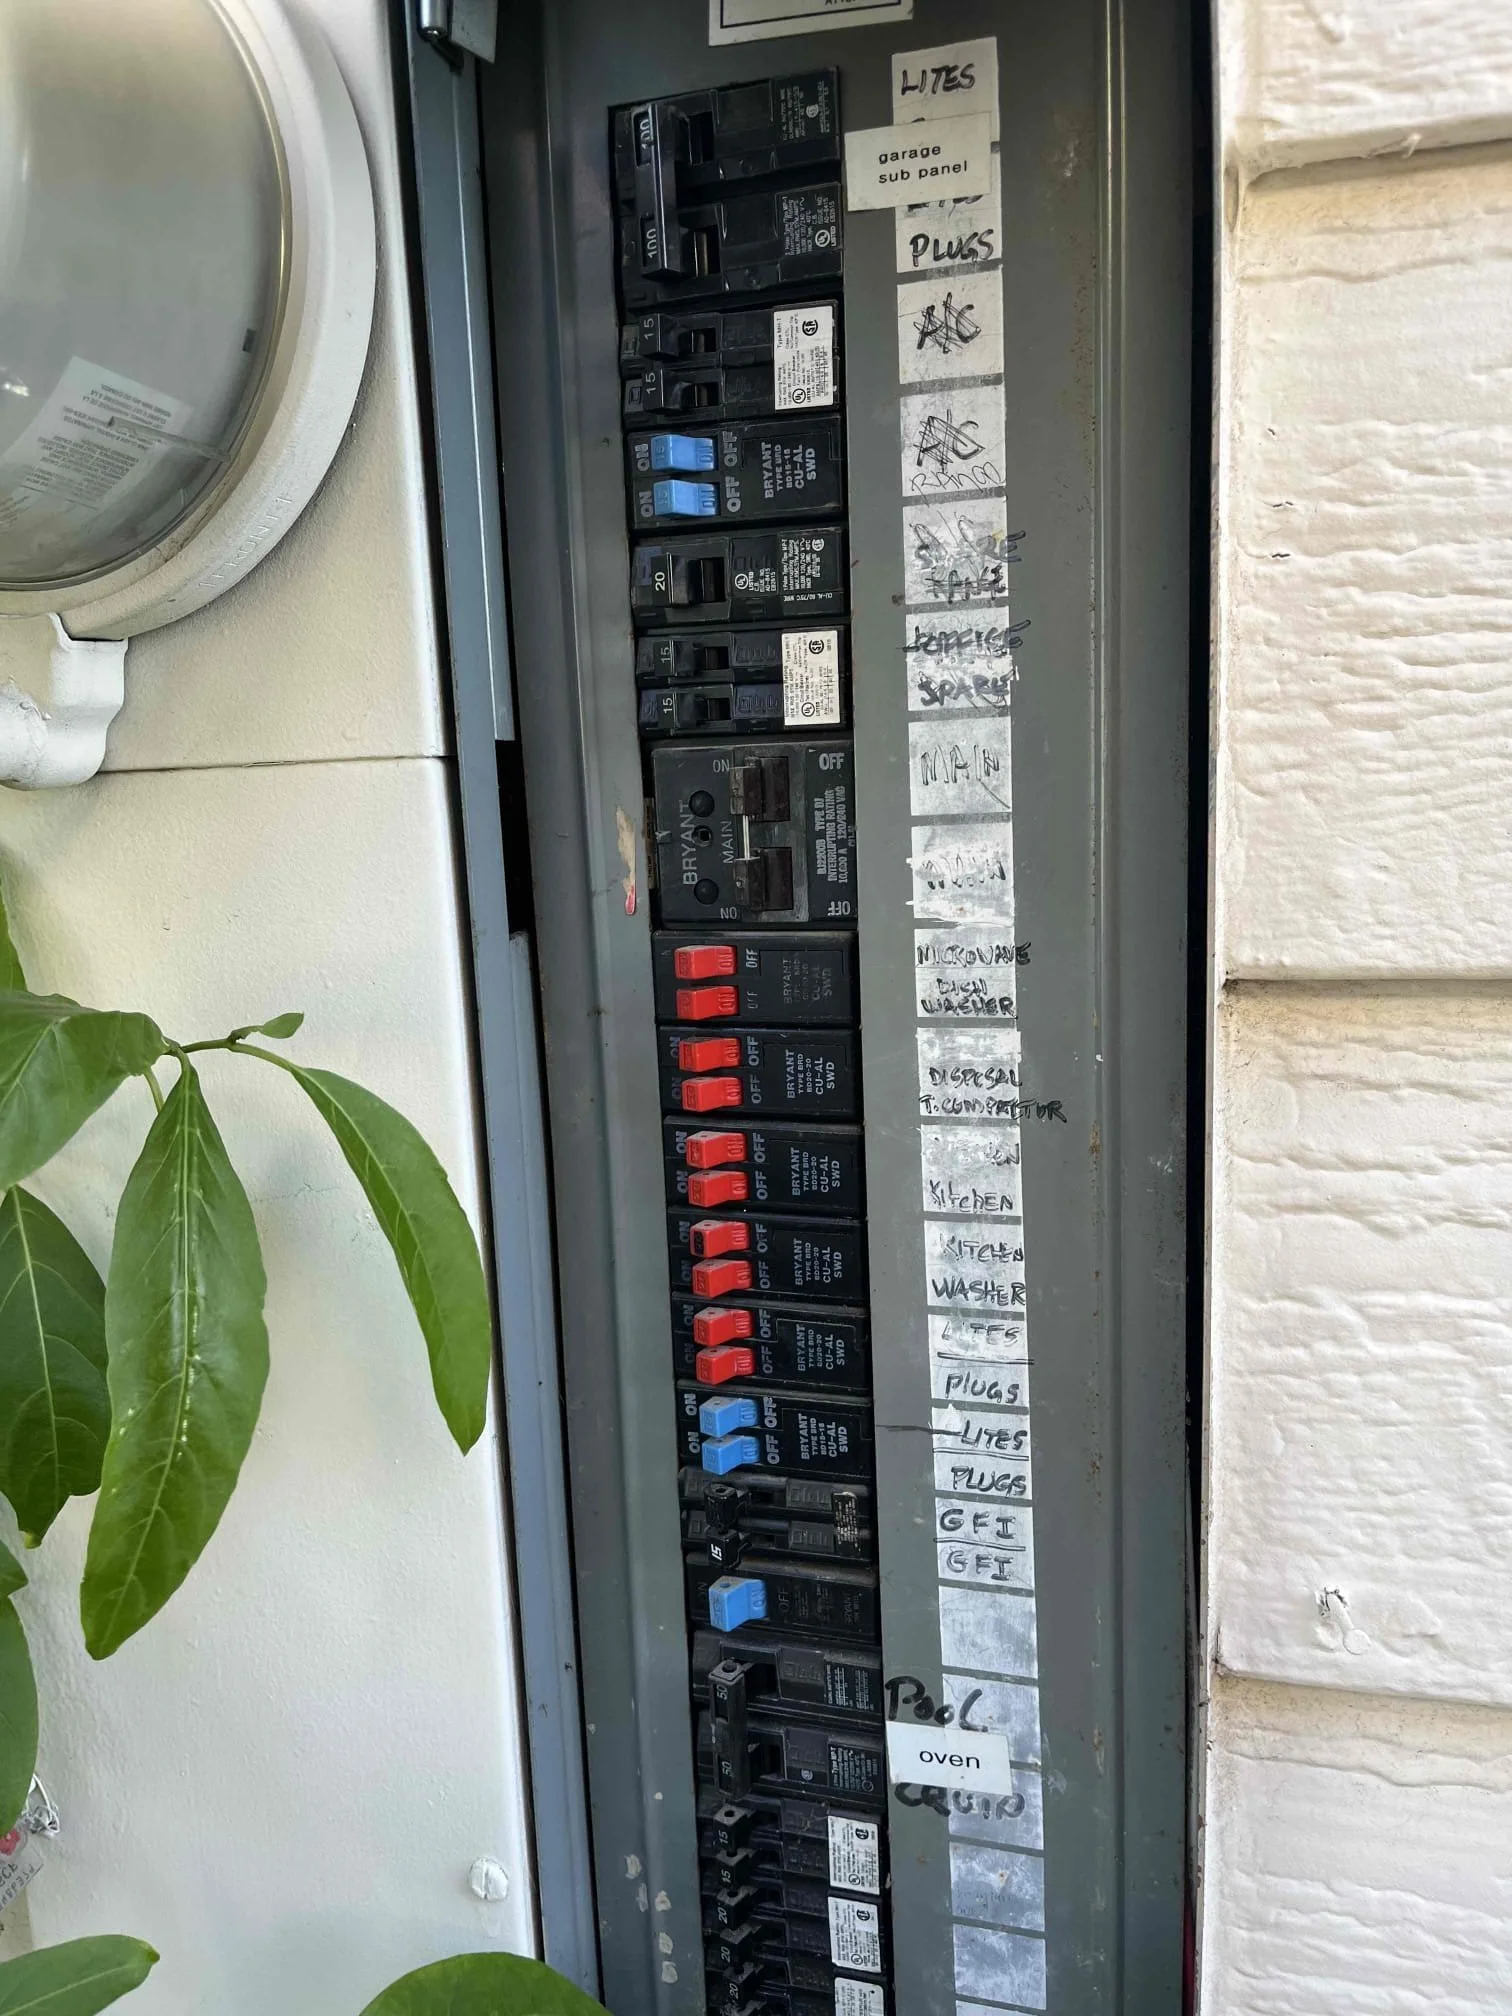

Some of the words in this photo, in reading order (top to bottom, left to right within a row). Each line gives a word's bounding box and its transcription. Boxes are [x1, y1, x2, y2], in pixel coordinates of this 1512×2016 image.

[901, 63, 976, 95] LITES
[879, 145, 942, 165] garage
[879, 169, 910, 183] sub
[919, 160, 968, 180] panel
[647, 228, 657, 259] 100
[909, 229, 995, 268] PLUGS
[643, 318, 655, 340] 15
[645, 372, 657, 394] 15
[635, 443, 649, 472] ON
[722, 430, 738, 468] OFF
[761, 442, 774, 499] BRYANT
[794, 444, 805, 489] CU-AL
[806, 448, 817, 481] SWD
[639, 491, 654, 518] ON
[725, 475, 741, 513] OFF
[655, 571, 666, 592] 20
[663, 697, 673, 714] 15
[713, 759, 730, 772] ON
[819, 753, 845, 770] OFF
[921, 745, 1000, 785] MAIN
[824, 790, 836, 820] RATING
[814, 812, 826, 831] TYPE
[836, 806, 847, 840] 120/240
[680, 800, 698, 885] BRYANT
[720, 820, 734, 864] MAIN
[827, 822, 837, 881] INTERRUPTING
[720, 907, 737, 920] ON
[827, 901, 851, 916] OFF
[745, 948, 759, 969] OFF
[747, 1036, 760, 1066] OFF
[786, 1049, 795, 1099] BRYANT
[814, 1056, 824, 1095] CU-AL
[826, 1061, 835, 1090] SWD
[750, 1074, 762, 1104] OFF
[676, 1130, 687, 1154] ON
[752, 1132, 766, 1163] OFF
[677, 1171, 688, 1194] ON
[755, 1170, 768, 1200] OFF
[790, 1147, 800, 1196] BRYANT
[820, 1155, 829, 1193] CU-AL
[831, 1160, 841, 1188] SWD
[679, 1220, 690, 1242] ON
[755, 1223, 768, 1253] OFF
[793, 1238, 803, 1286] BRYANT
[940, 1233, 1024, 1263] KITCHEN
[758, 1260, 770, 1289] OFF
[822, 1246, 831, 1283] CU-AL
[833, 1251, 843, 1278] SWD
[932, 1277, 1026, 1306] WASHER
[759, 1308, 772, 1338] OFF
[942, 1321, 1020, 1347] LTES
[761, 1345, 774, 1374] OFF
[796, 1323, 806, 1372] BRYANT
[824, 1334, 834, 1370] CU-AL
[836, 1339, 845, 1366] SWD
[684, 1393, 697, 1416] ON
[763, 1396, 777, 1428] OFF
[688, 1432, 700, 1454] ON
[765, 1434, 780, 1465] OFF
[798, 1413, 809, 1460] BRYANT
[827, 1421, 837, 1457] CU-AL
[838, 1426, 848, 1453] SWD
[961, 1420, 1028, 1450] LITES
[951, 1466, 1026, 1496] PLUGS
[710, 1543, 723, 1561] 15
[716, 1685, 728, 1700] 50
[721, 1761, 732, 1777] 50
[919, 1750, 980, 1769] oven
[718, 1830, 728, 1844] 15
[722, 1869, 731, 1884] 15
[718, 1907, 728, 1925] 20
[721, 1946, 731, 1963] 20
[729, 1983, 739, 2000] 20
